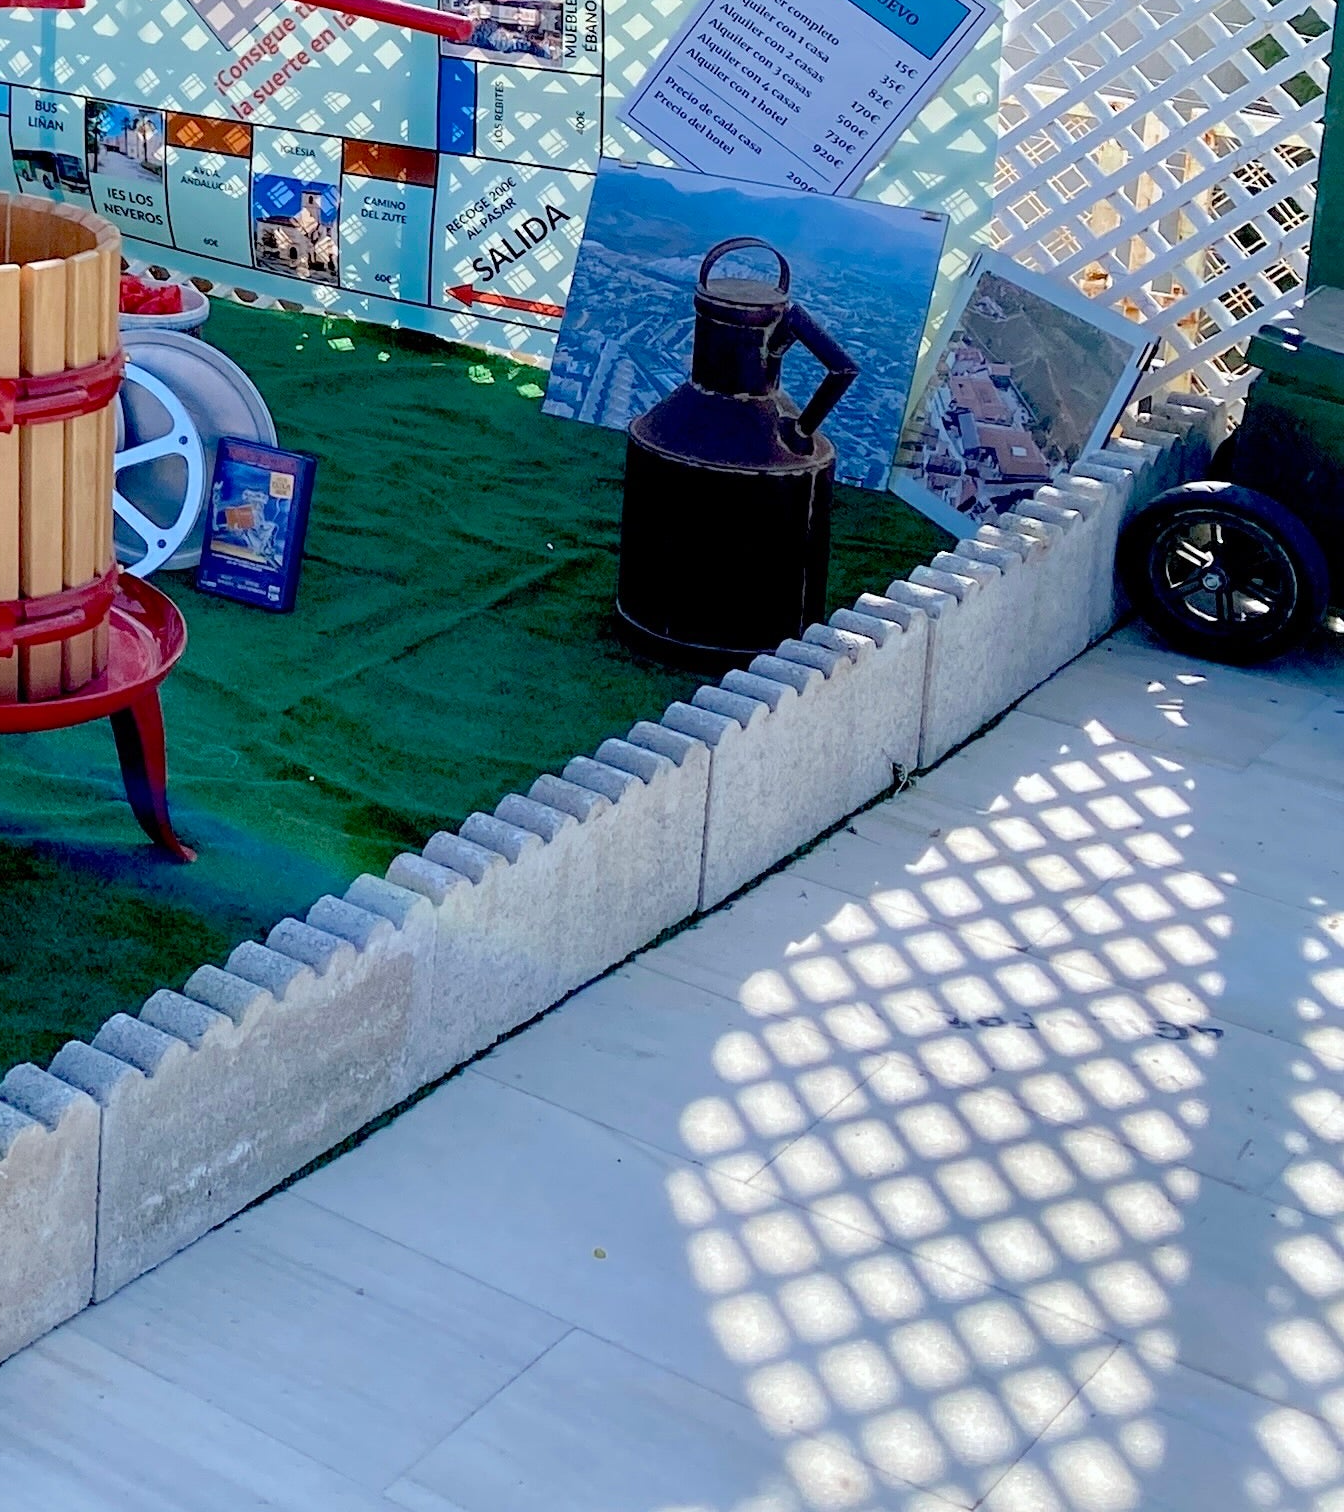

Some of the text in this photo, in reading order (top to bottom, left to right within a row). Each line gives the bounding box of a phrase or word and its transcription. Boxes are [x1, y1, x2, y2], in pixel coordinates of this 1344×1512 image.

[583, 0, 598, 53] ÉBANO
[214, 15, 297, 97] ¡Consigue
[231, 102, 253, 120] la
[253, 51, 311, 105] suerte
[311, 29, 336, 54] en
[895, 59, 919, 80] 15€
[34, 99, 58, 115] BUS
[495, 81, 504, 122] REBITES
[28, 113, 64, 132] LIÑAN
[280, 146, 316, 158] IGLESIA
[812, 144, 845, 170] 920€
[107, 188, 154, 207] IES LOS
[363, 195, 406, 211] CAMINO
[446, 177, 517, 235] RECOGE 200€
[104, 203, 164, 226] NEVEROS
[361, 208, 408, 225] DEL ZUTE
[467, 198, 517, 240] AL PASAR
[473, 204, 571, 282] SALIDA
